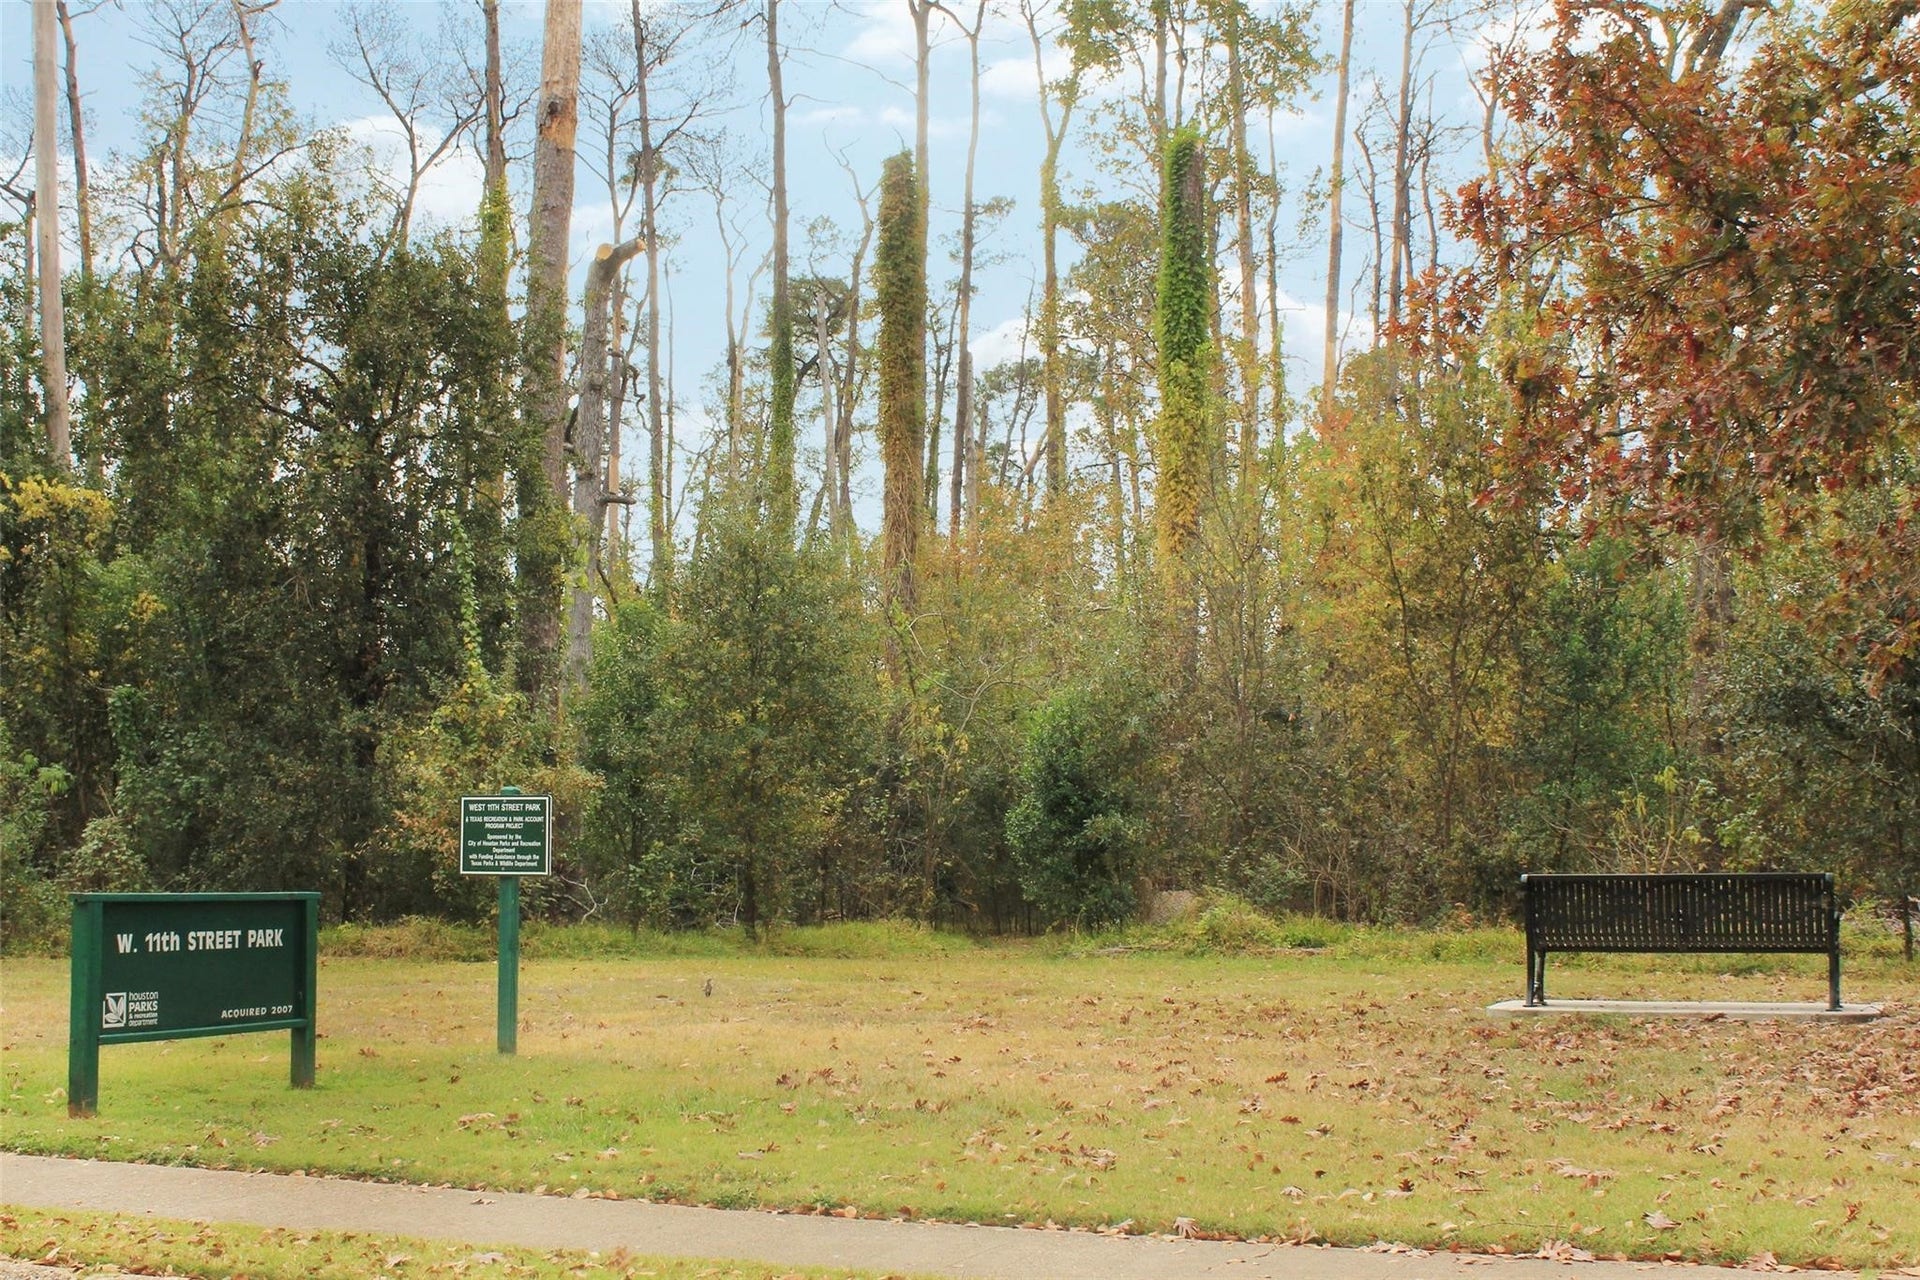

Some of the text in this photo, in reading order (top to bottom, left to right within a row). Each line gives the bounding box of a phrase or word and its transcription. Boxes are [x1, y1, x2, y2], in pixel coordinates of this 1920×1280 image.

[116, 928, 284, 954] W. 11th STREET PARK
[129, 991, 159, 1001] houston
[129, 1001, 158, 1011] PARKS
[221, 1005, 293, 1019] ACQUIRED 2007
[129, 1018, 158, 1027] department
